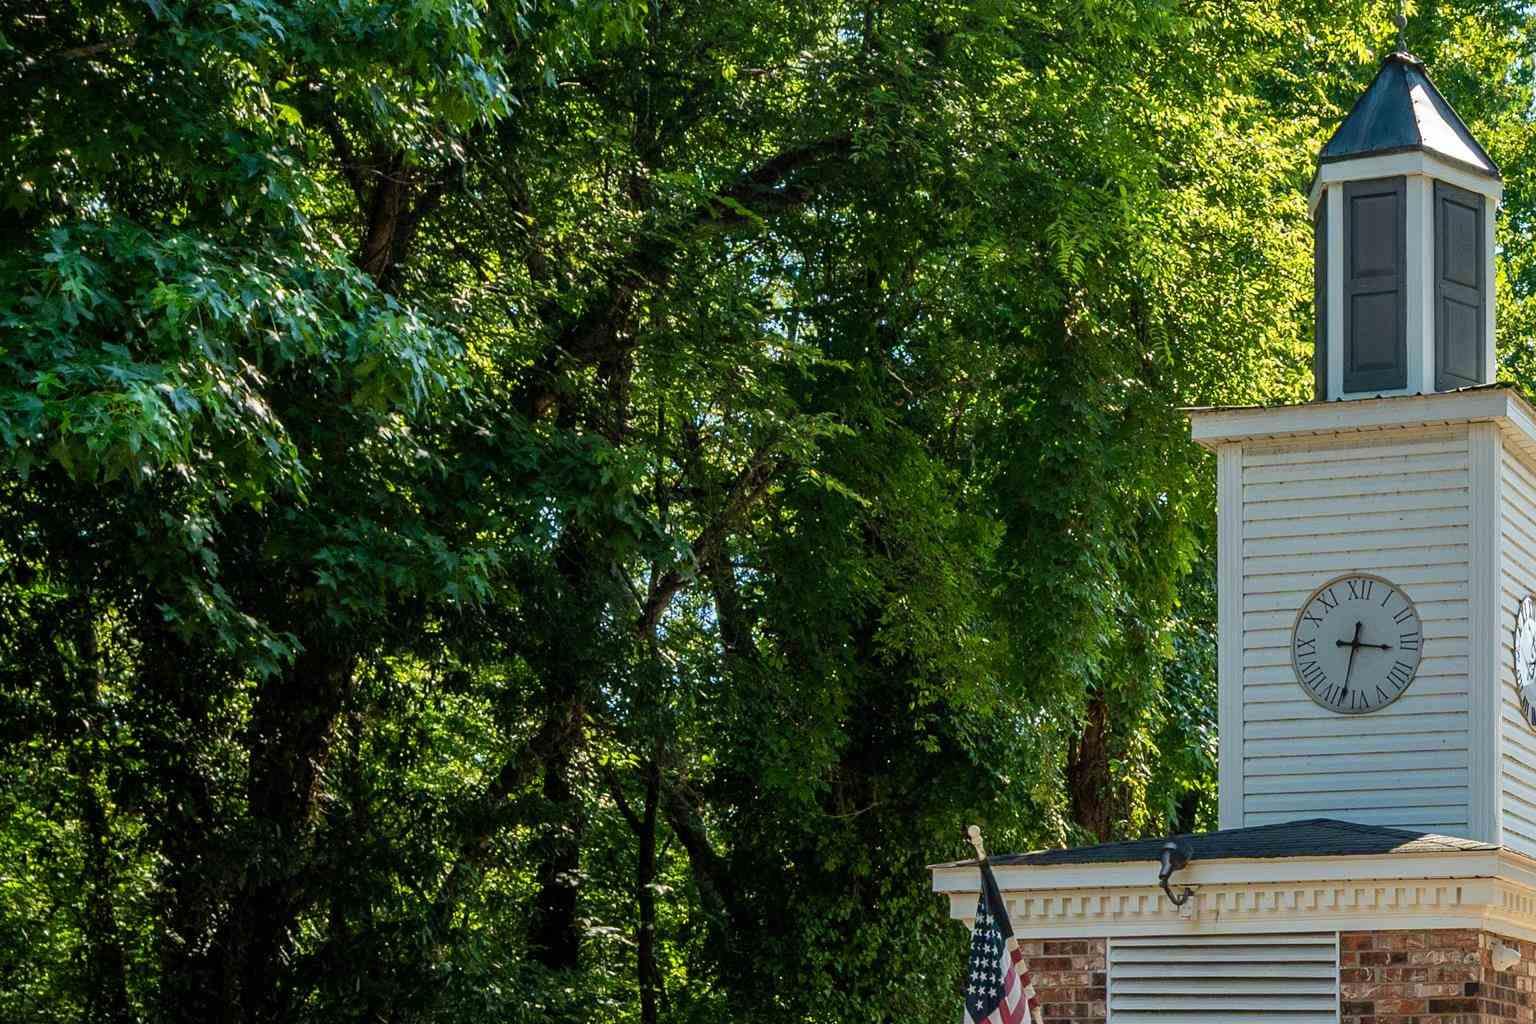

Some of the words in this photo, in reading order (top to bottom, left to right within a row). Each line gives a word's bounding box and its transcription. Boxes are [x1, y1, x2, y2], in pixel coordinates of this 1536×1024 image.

[1347, 580, 1374, 600] XII
[1380, 589, 1394, 607] I
[1316, 588, 1339, 614] XI
[1303, 610, 1323, 628] X
[1393, 606, 1413, 624] II
[1298, 638, 1316, 657] IX
[1400, 632, 1418, 651] III
